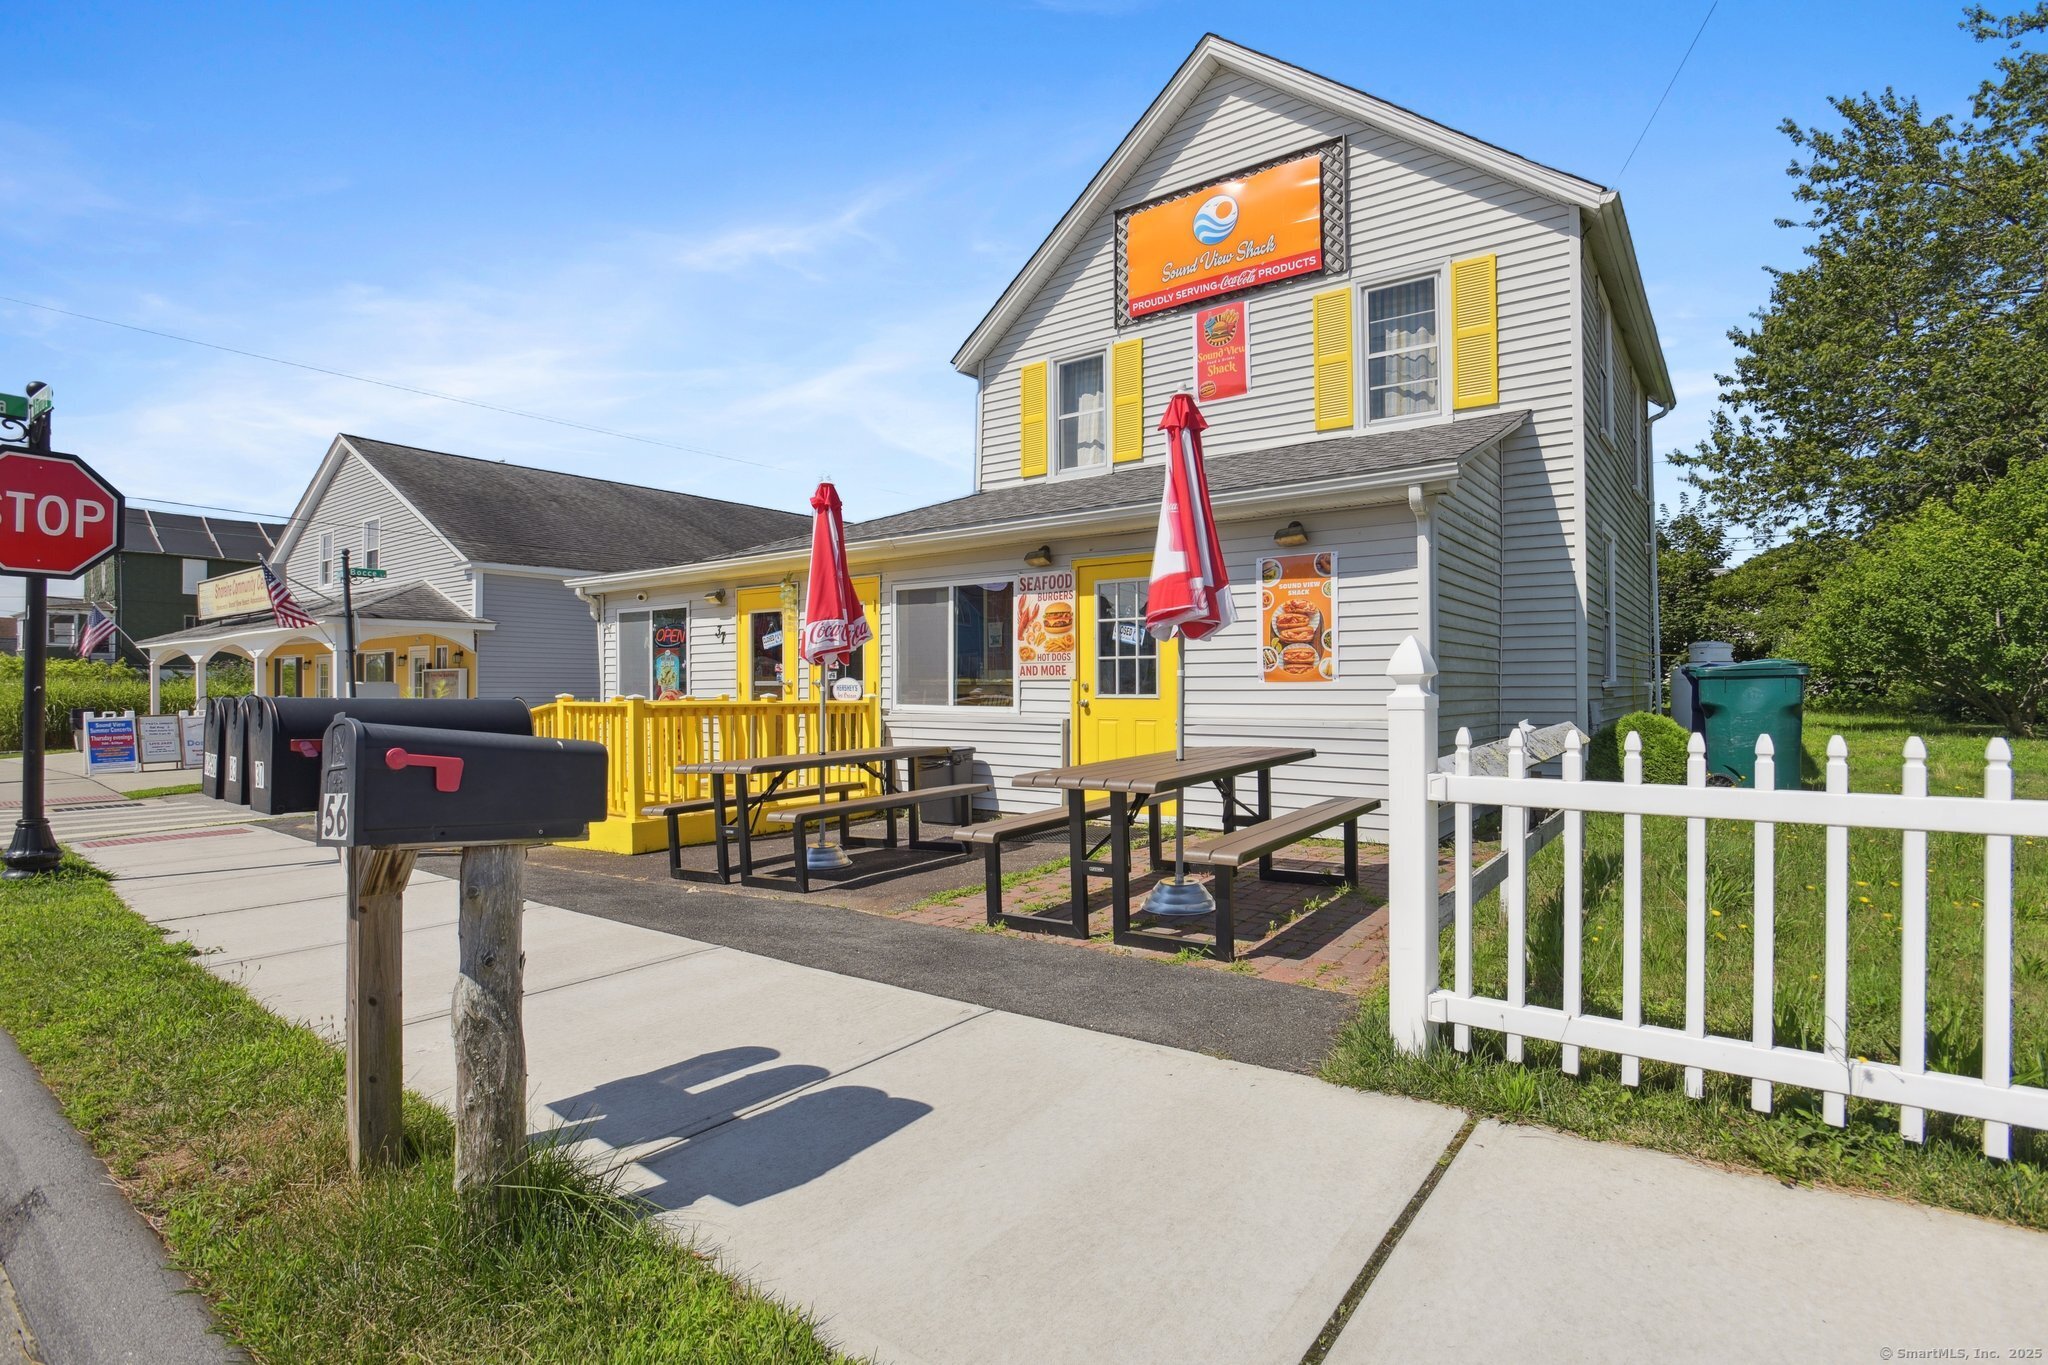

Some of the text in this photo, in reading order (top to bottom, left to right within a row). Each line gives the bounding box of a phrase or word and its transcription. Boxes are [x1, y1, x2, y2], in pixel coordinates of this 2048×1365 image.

[1161, 235, 1276, 282] Sound View Shack
[1132, 294, 1174, 312] PROUDLY
[1175, 281, 1218, 300] SERVING
[1258, 256, 1317, 278] PRODUCTS
[1197, 345, 1246, 363] Sound View
[1207, 361, 1238, 377] Shack
[0, 491, 105, 538] TOP
[232, 576, 256, 596] Community
[1019, 573, 1073, 592] SEAFOOD
[1279, 582, 1302, 590] SOUND
[1037, 590, 1074, 602] BURGERS
[656, 628, 686, 643] OPEN
[715, 625, 726, 645] 37
[1037, 652, 1072, 662] HOT DOGS
[1020, 664, 1067, 677] AND MORE
[325, 794, 347, 838] 56
